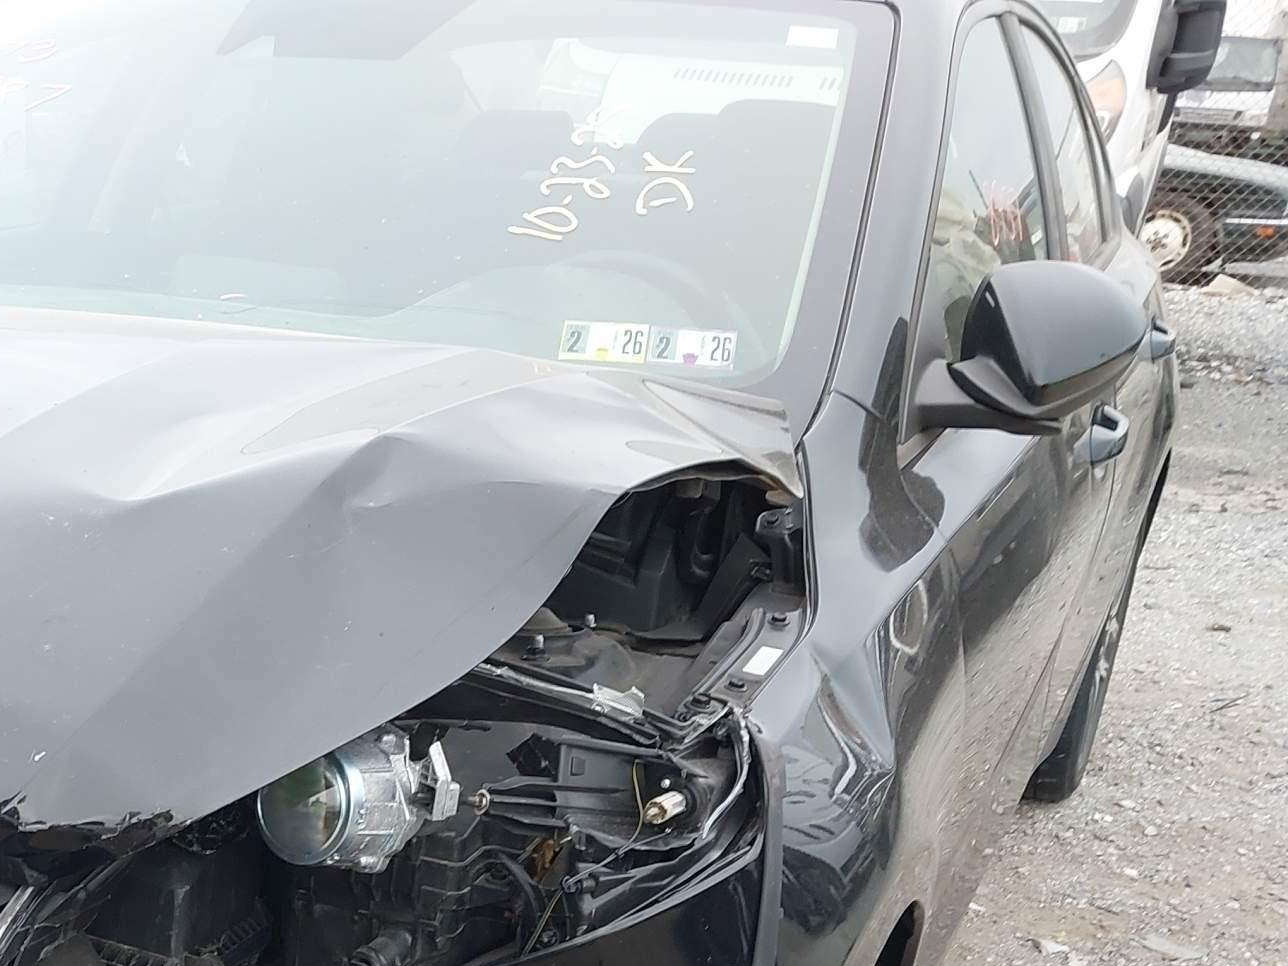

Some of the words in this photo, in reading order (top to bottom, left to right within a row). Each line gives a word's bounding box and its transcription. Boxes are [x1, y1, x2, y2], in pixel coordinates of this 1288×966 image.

[566, 330, 583, 354] 2
[620, 329, 644, 356] 26
[656, 336, 672, 360] 2
[709, 335, 733, 363] 26
